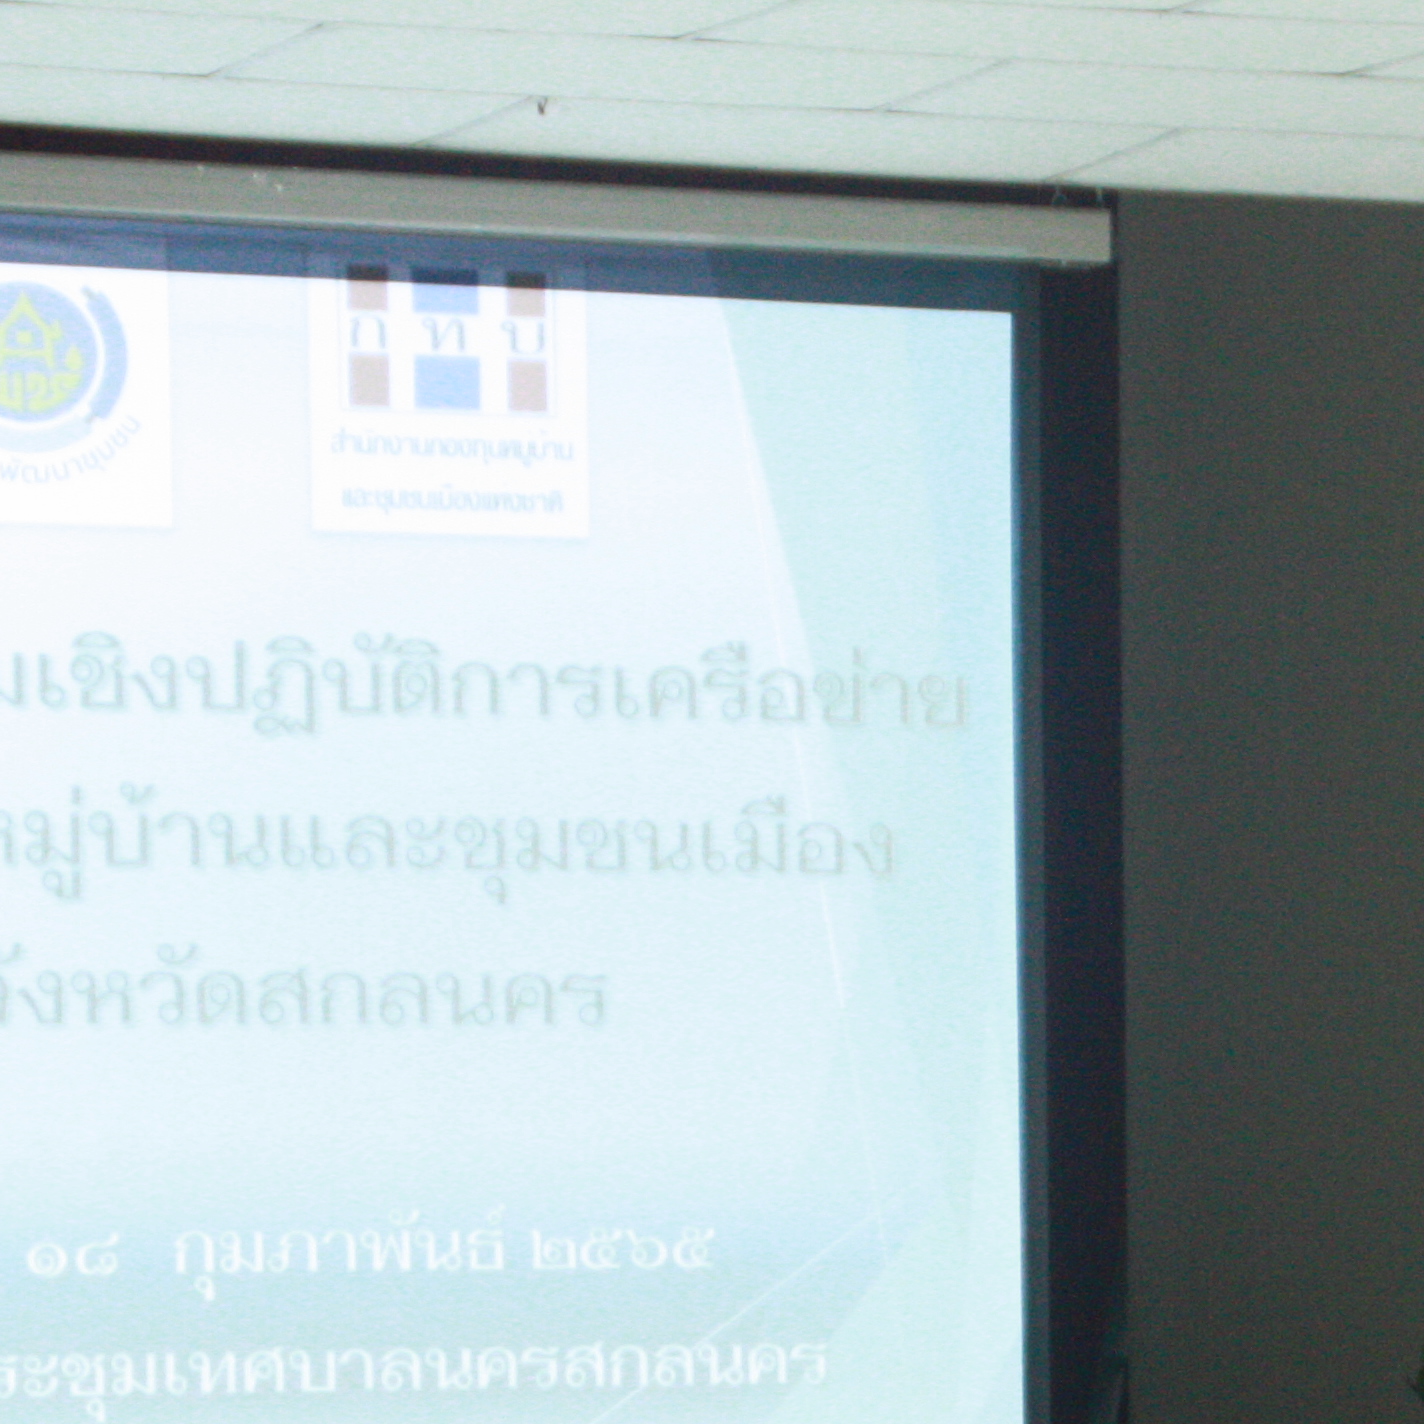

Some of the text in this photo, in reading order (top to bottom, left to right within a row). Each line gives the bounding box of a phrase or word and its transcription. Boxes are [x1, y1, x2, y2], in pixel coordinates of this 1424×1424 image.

[25, 1231, 122, 1277] ๑๘
[172, 1203, 507, 1302] กุมภาพันธ์
